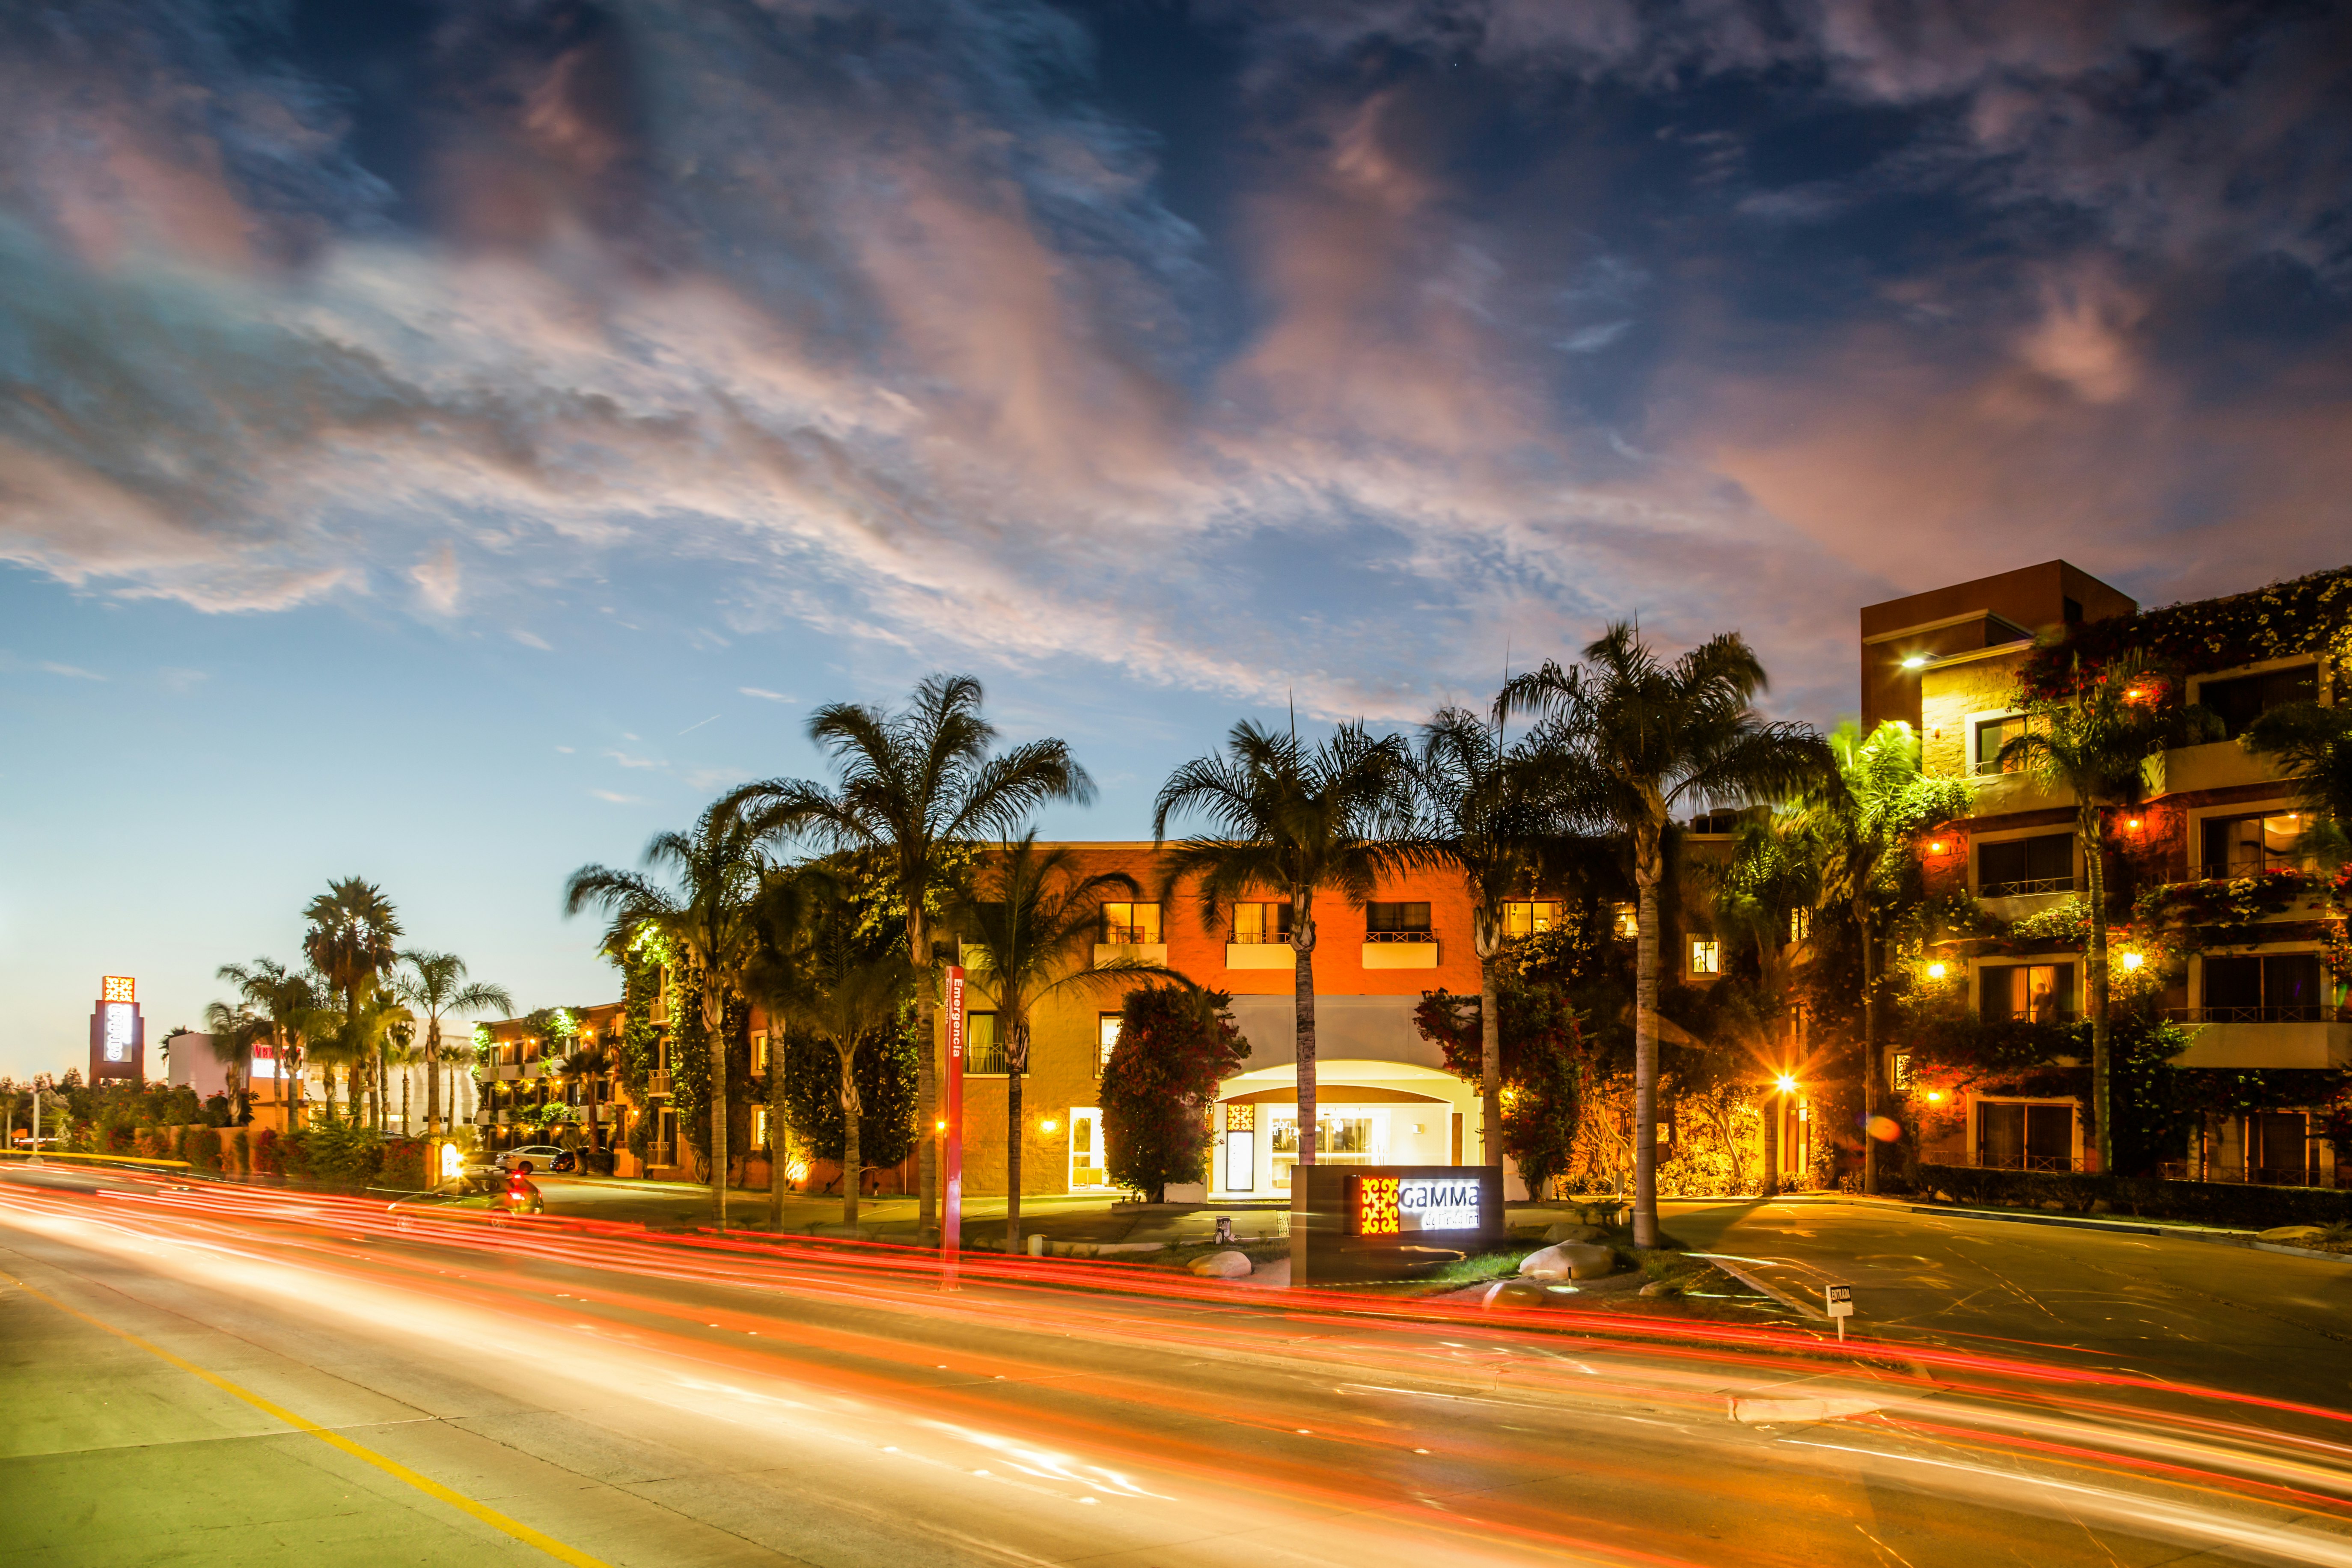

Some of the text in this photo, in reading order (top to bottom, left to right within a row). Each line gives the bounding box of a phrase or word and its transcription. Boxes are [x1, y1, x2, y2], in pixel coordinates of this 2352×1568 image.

[952, 979, 963, 1057] Emergencia
[1426, 1213, 1435, 1226] de
[1831, 1288, 1851, 1300] ENTRADA
